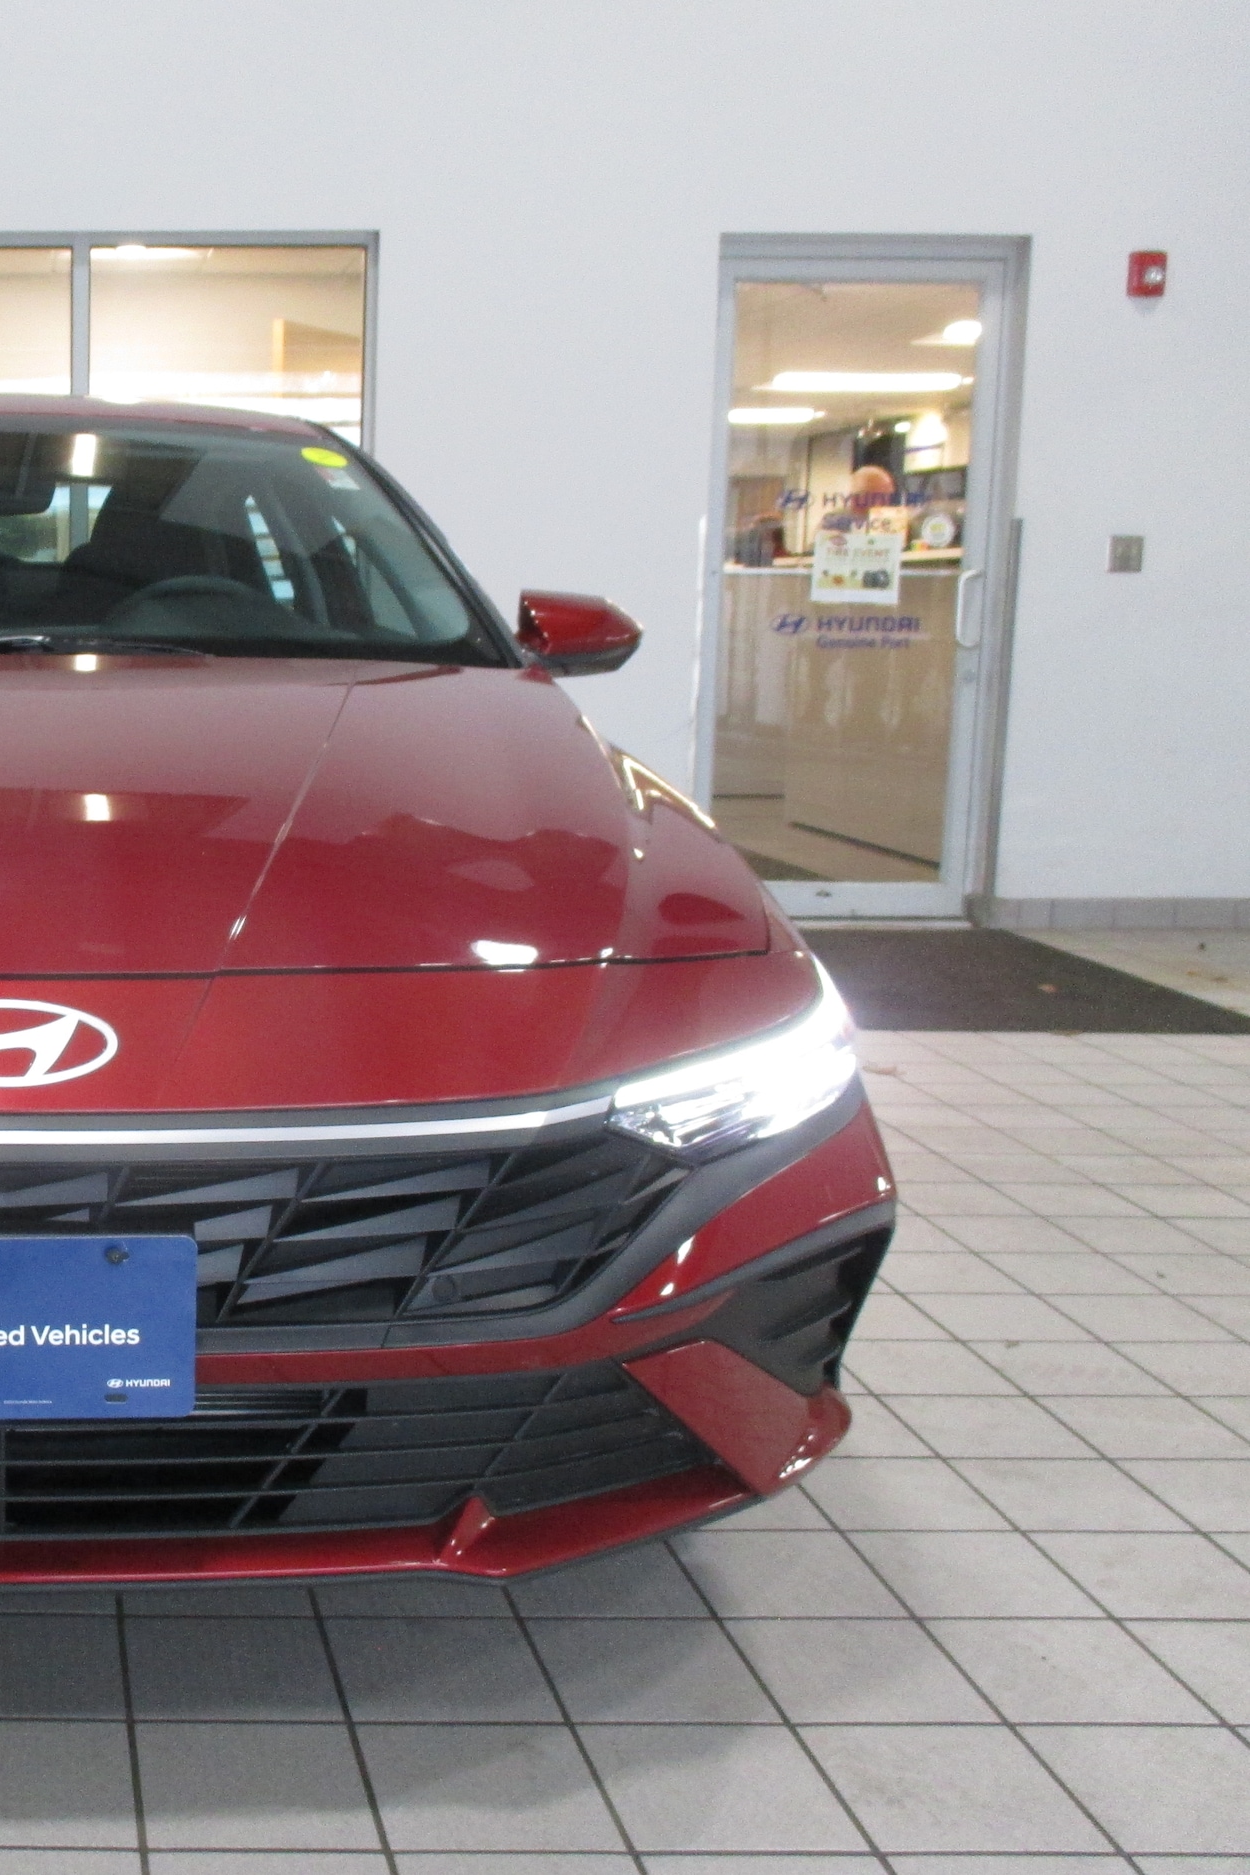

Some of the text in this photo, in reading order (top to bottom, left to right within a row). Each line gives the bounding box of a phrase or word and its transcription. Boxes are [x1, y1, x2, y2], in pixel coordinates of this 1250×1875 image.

[816, 615, 920, 632] HYUNDAI
[31, 1324, 140, 1346] Vehicles
[125, 1379, 171, 1388] HYUNDAI
